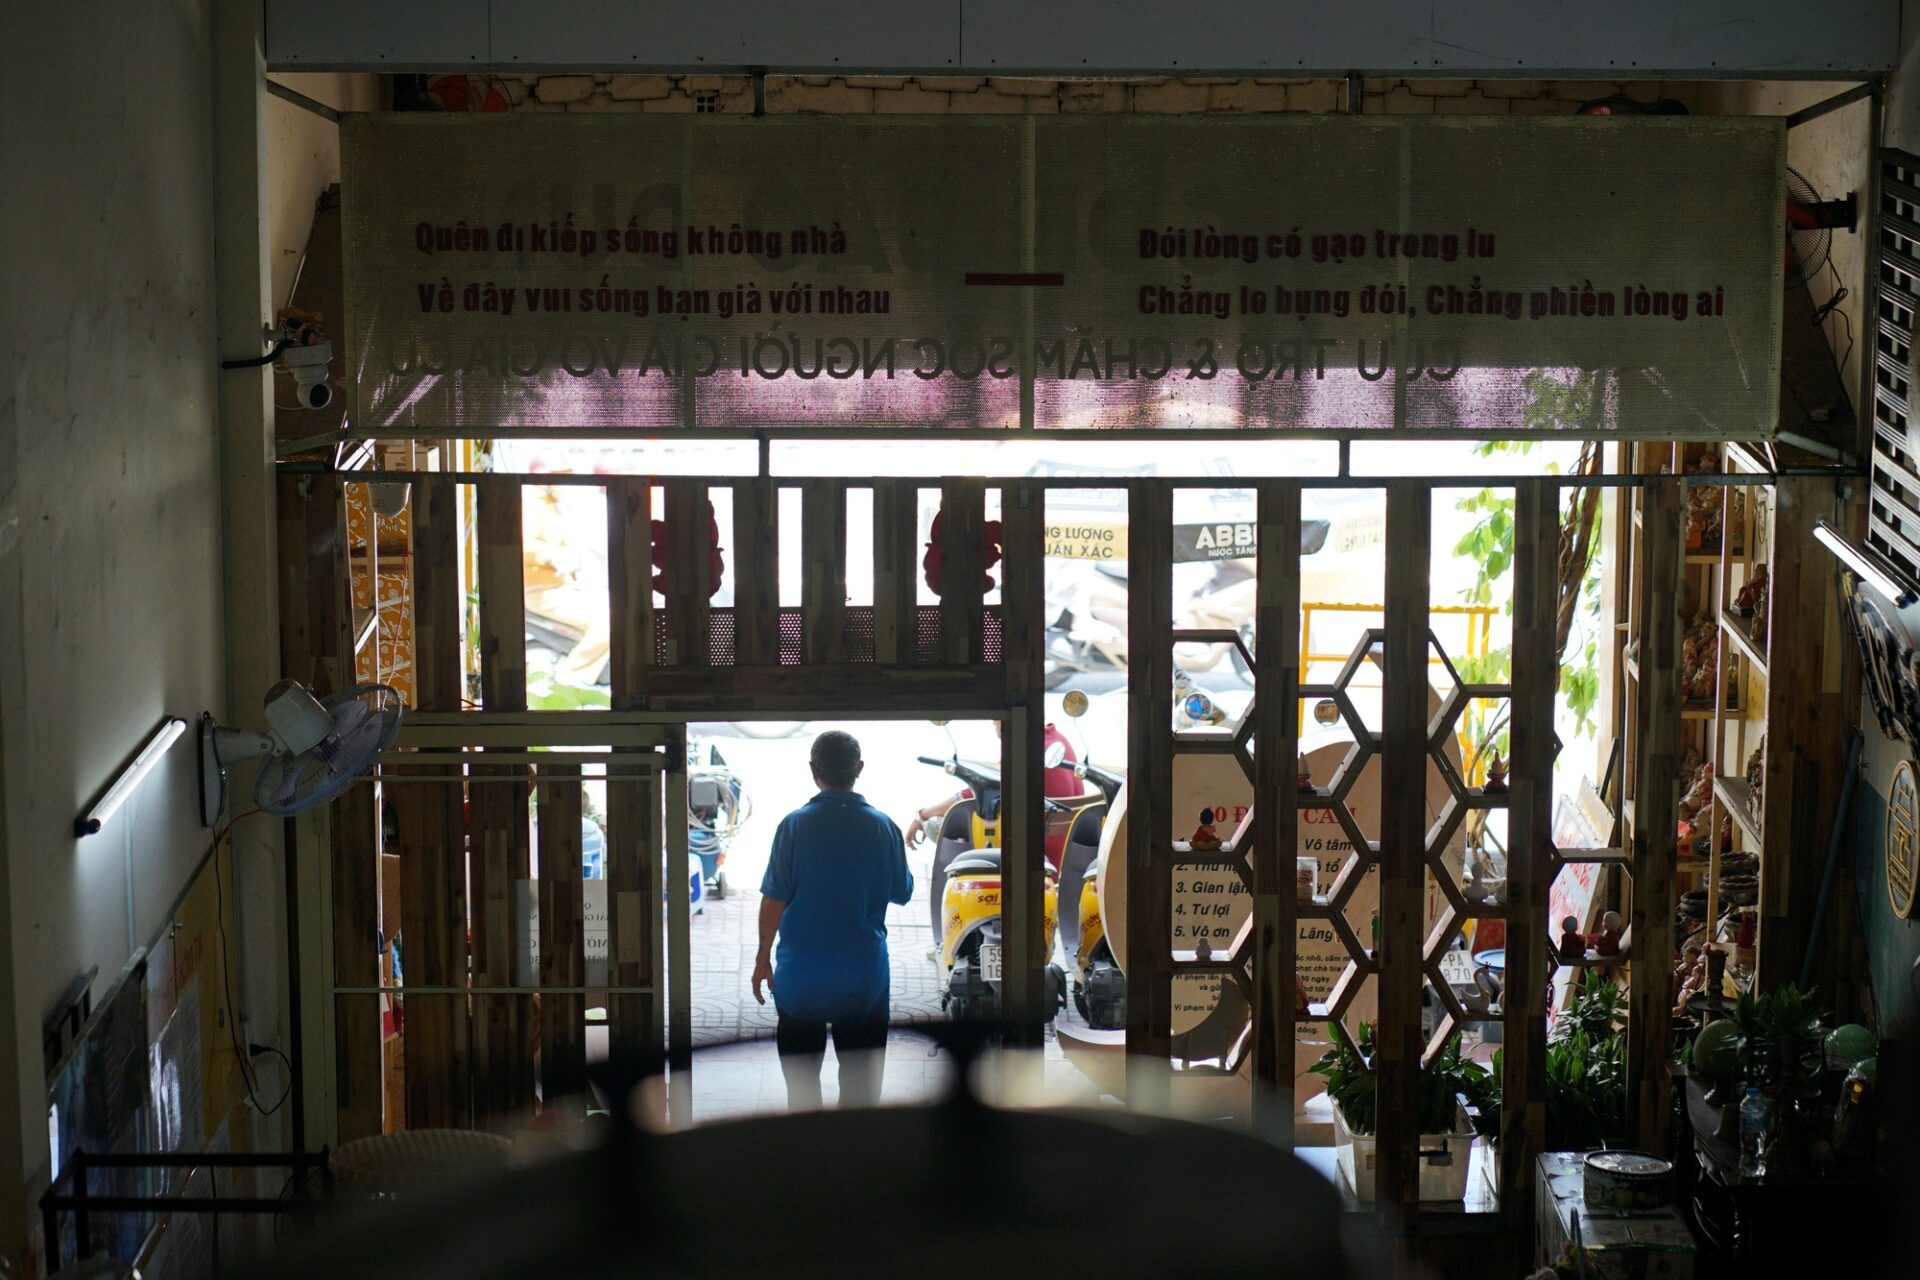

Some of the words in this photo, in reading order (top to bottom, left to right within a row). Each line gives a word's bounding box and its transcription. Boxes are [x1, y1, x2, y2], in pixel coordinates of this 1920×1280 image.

[415, 221, 490, 255] Quên
[530, 212, 597, 257] kiếp
[606, 215, 678, 259] sống
[688, 223, 782, 259] không
[791, 221, 847, 254] nhà
[1138, 226, 1187, 258] Đói
[1194, 226, 1258, 263] lòng
[1266, 226, 1301, 258] có
[1311, 232, 1366, 263] gạo
[1375, 229, 1459, 262] trong
[1466, 228, 1496, 258] lu
[418, 276, 454, 313] Về
[463, 281, 516, 316] đây
[525, 287, 571, 313] vui
[578, 274, 649, 318] sống
[656, 285, 710, 321] bạn
[718, 282, 762, 318] già
[769, 282, 812, 314] với
[819, 286, 890, 314] nhau
[1138, 275, 1231, 319] Chẳng
[1240, 285, 1267, 314] lo
[1276, 285, 1350, 321] bụng
[1359, 283, 1416, 319] đói,
[1426, 276, 1522, 320] Chẳng
[1530, 279, 1615, 320] phiền
[1624, 284, 1688, 321] lòng
[1696, 285, 1724, 317] ai
[1195, 522, 1257, 550] ABB
[1079, 542, 1114, 559] XÁC
[1304, 838, 1322, 850] Vô
[1175, 881, 1187, 893] 3.
[1192, 881, 1224, 893] Gian
[1175, 904, 1187, 915] 4.
[1192, 904, 1210, 915] Tư
[1212, 904, 1231, 918] lợi
[1174, 926, 1186, 937] 5.
[1191, 926, 1209, 937] Vô
[1213, 926, 1230, 937] ơn
[1299, 927, 1334, 942] Lãng
[989, 948, 1001, 963] 59
[1442, 953, 1465, 967] -PA
[988, 964, 1001, 979] 16
